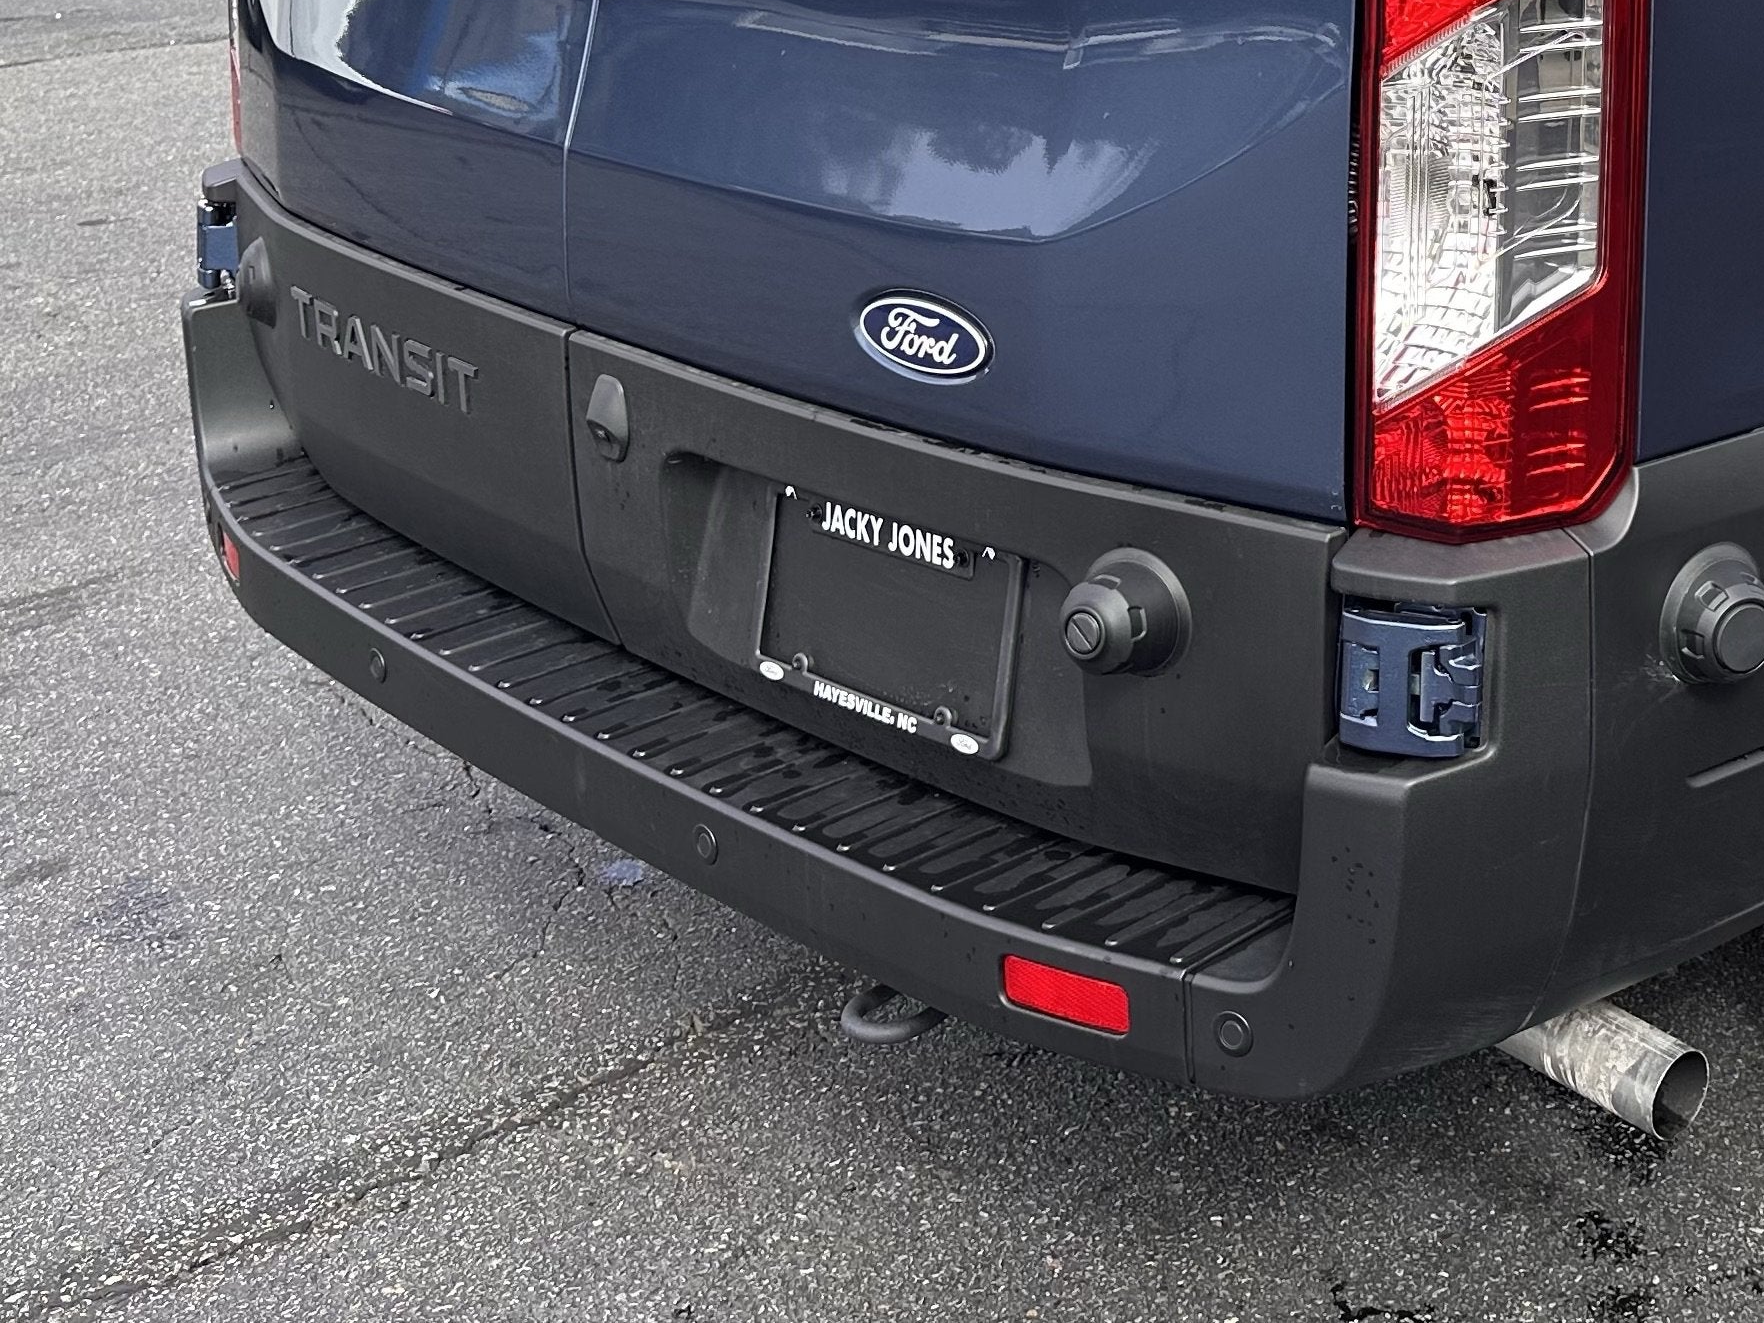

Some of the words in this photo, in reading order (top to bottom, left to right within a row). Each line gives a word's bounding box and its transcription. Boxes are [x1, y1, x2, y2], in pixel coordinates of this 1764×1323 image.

[290, 285, 479, 414] TRANSIT
[880, 307, 959, 365] Ford
[822, 501, 884, 546] JACKY
[888, 522, 955, 569] JONES
[813, 680, 895, 725] HAYESVILLE,
[897, 713, 918, 733] NC
